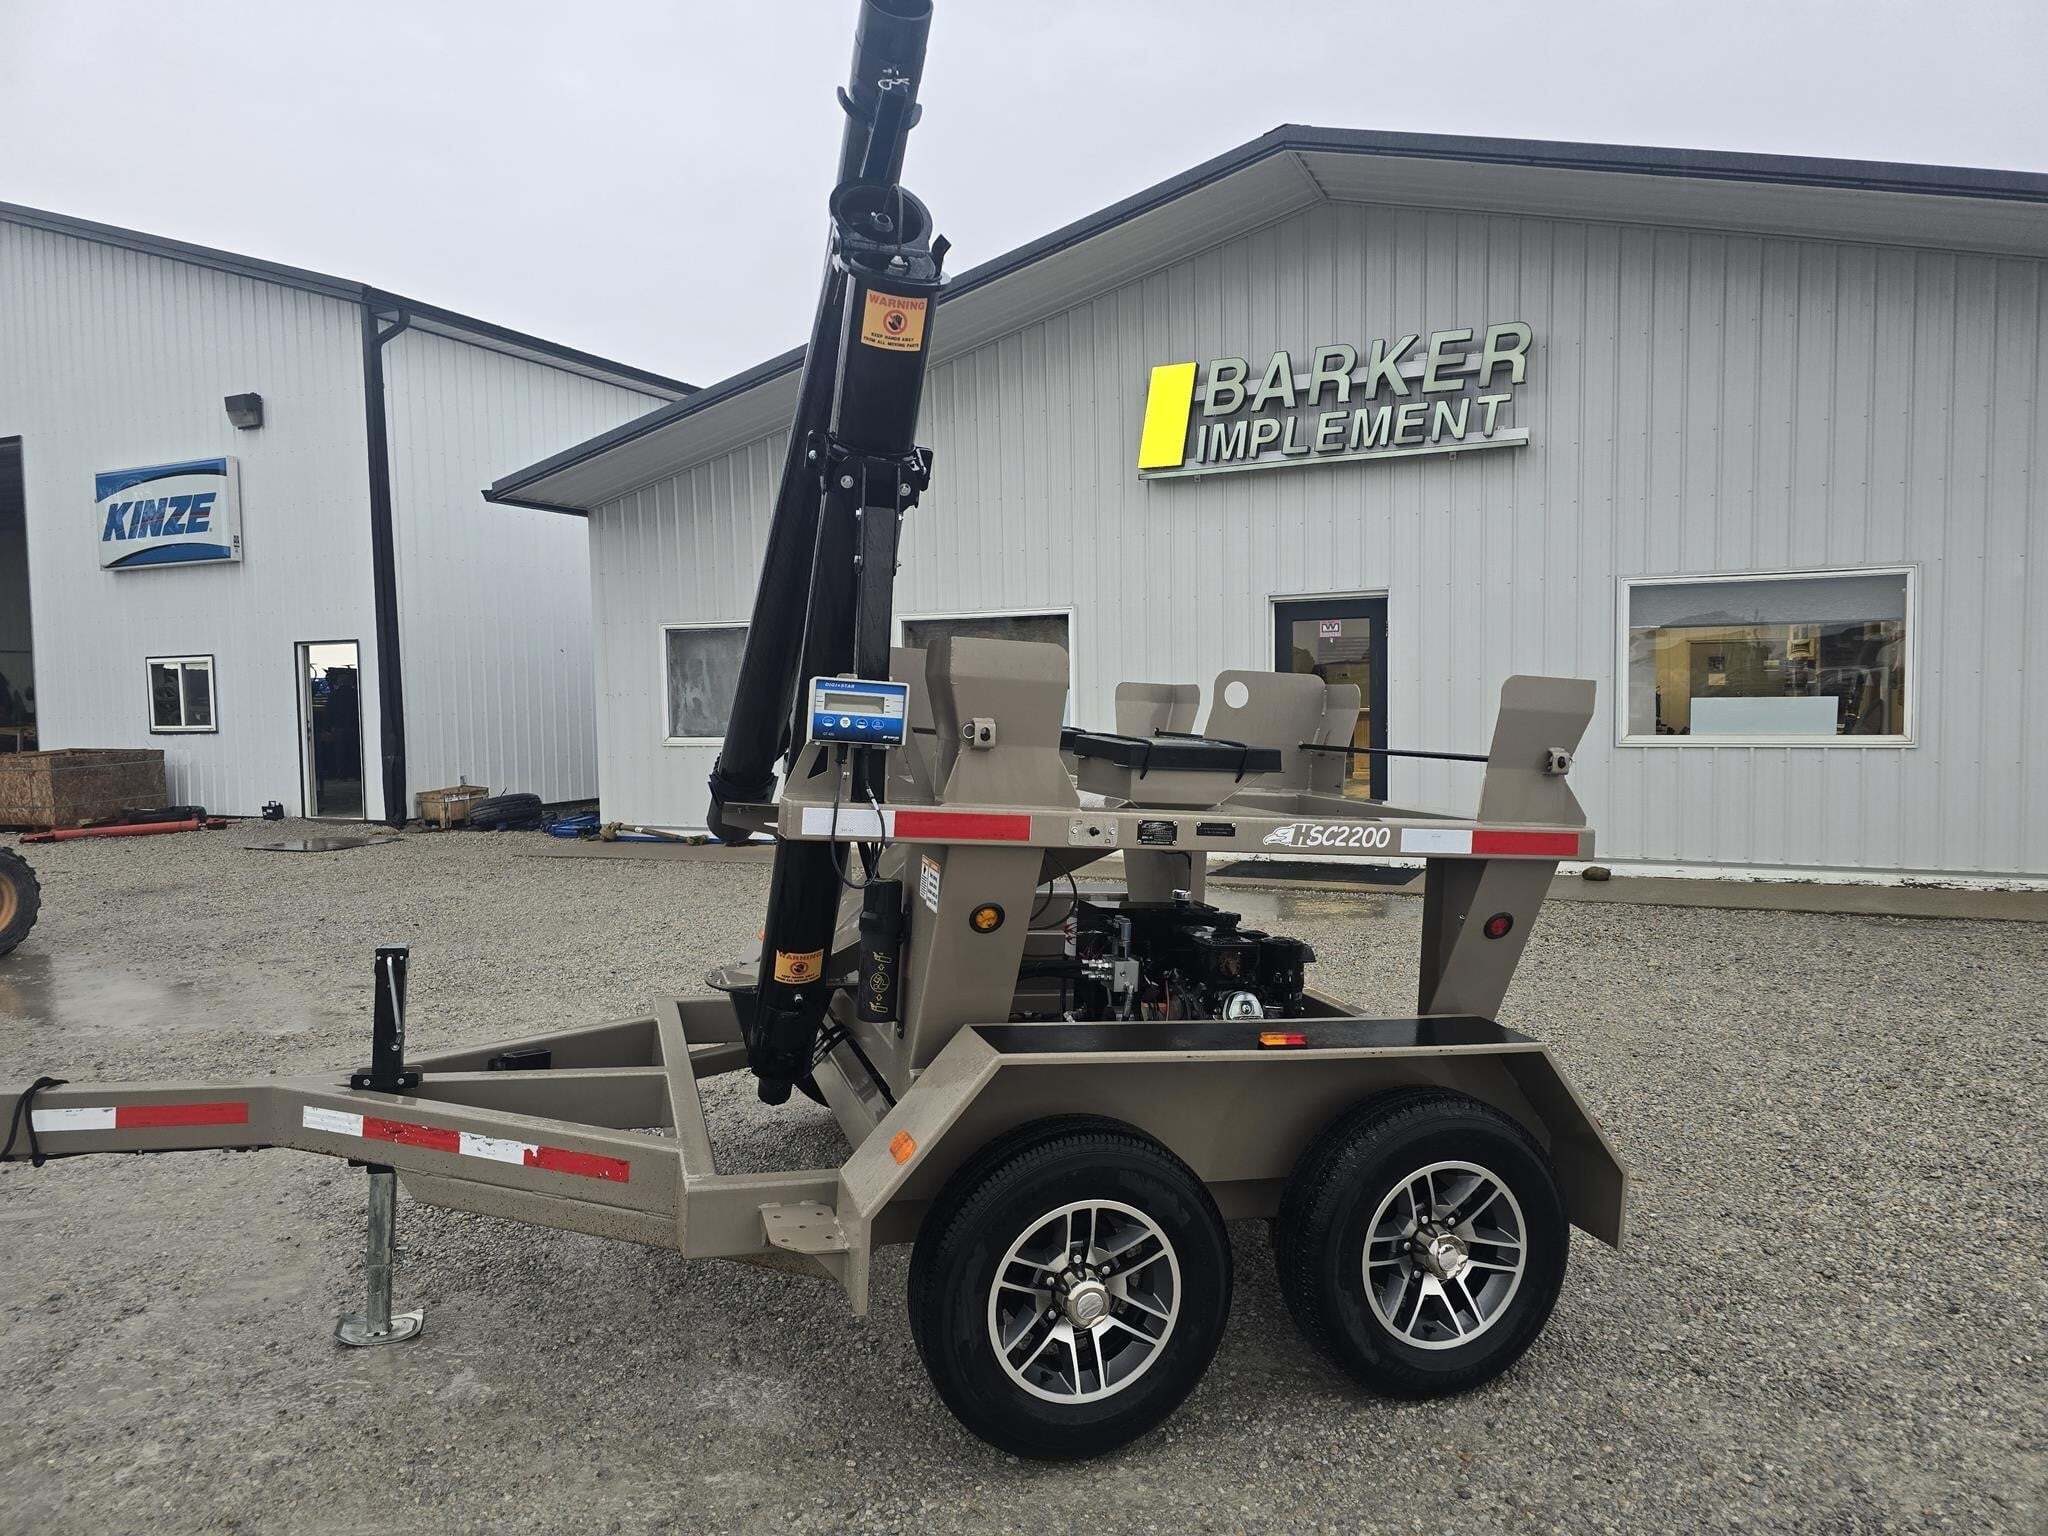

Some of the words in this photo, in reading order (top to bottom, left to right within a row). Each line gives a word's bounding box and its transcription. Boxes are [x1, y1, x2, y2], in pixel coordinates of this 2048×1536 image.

[869, 294, 925, 310] WARNING
[1203, 321, 1533, 417] BARKER
[1196, 393, 1512, 463] IMPLEMENT
[102, 492, 217, 541] KINZE
